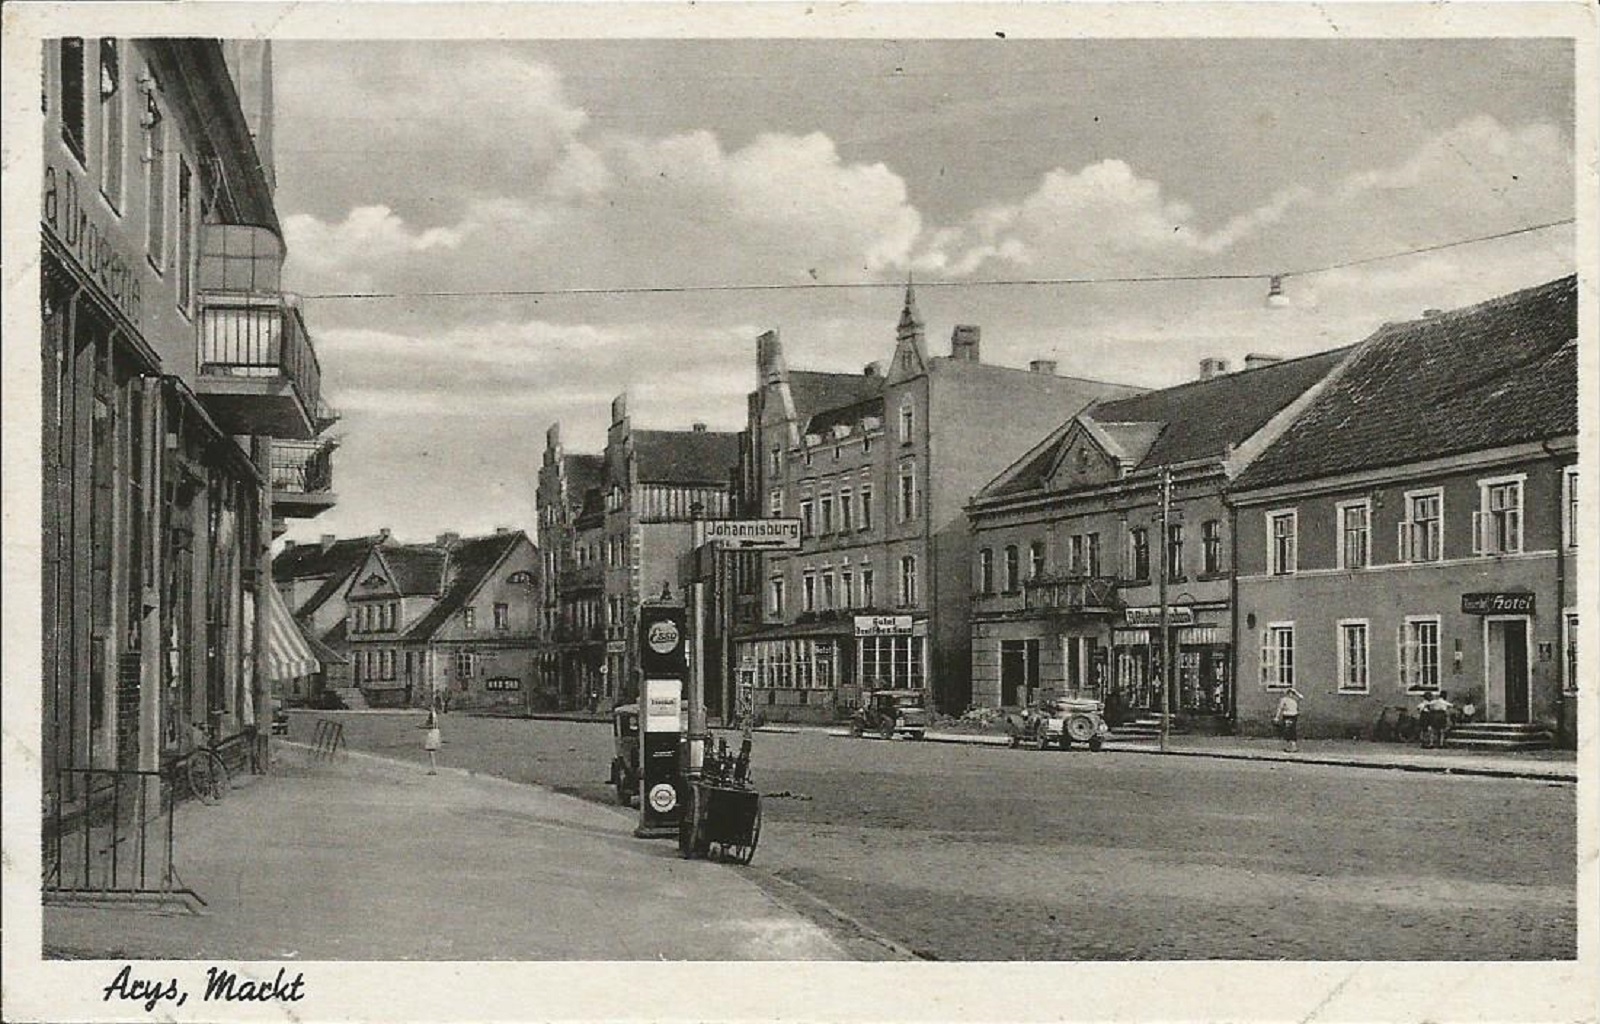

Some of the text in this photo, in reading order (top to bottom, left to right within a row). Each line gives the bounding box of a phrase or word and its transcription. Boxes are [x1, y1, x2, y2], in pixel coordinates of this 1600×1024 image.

[707, 521, 798, 539] Johannisburg
[1491, 594, 1533, 610] Hotel
[649, 626, 677, 645] Esso
